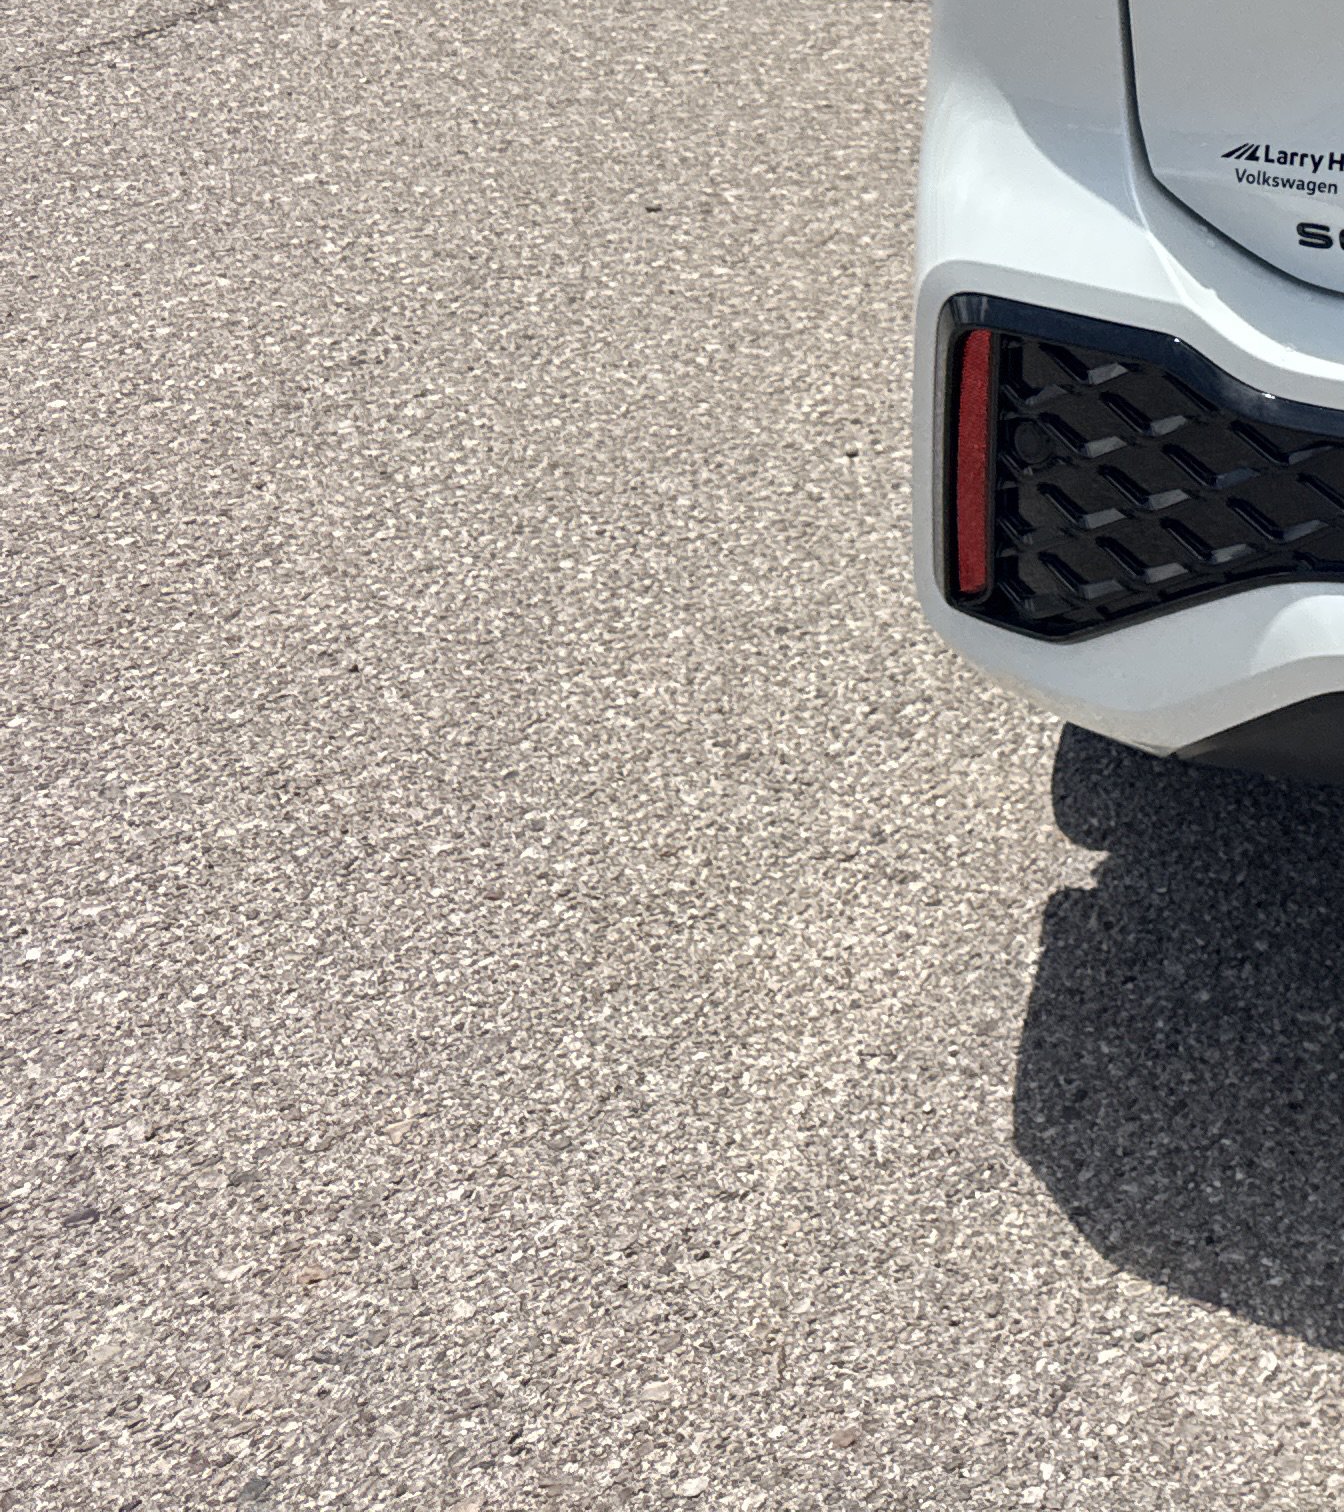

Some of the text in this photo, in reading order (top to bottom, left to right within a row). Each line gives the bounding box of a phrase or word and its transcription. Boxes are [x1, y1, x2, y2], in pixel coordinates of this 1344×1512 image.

[1264, 144, 1324, 173] Larry
[1327, 151, 1344, 172] H
[1234, 167, 1338, 196] Volkswagen
